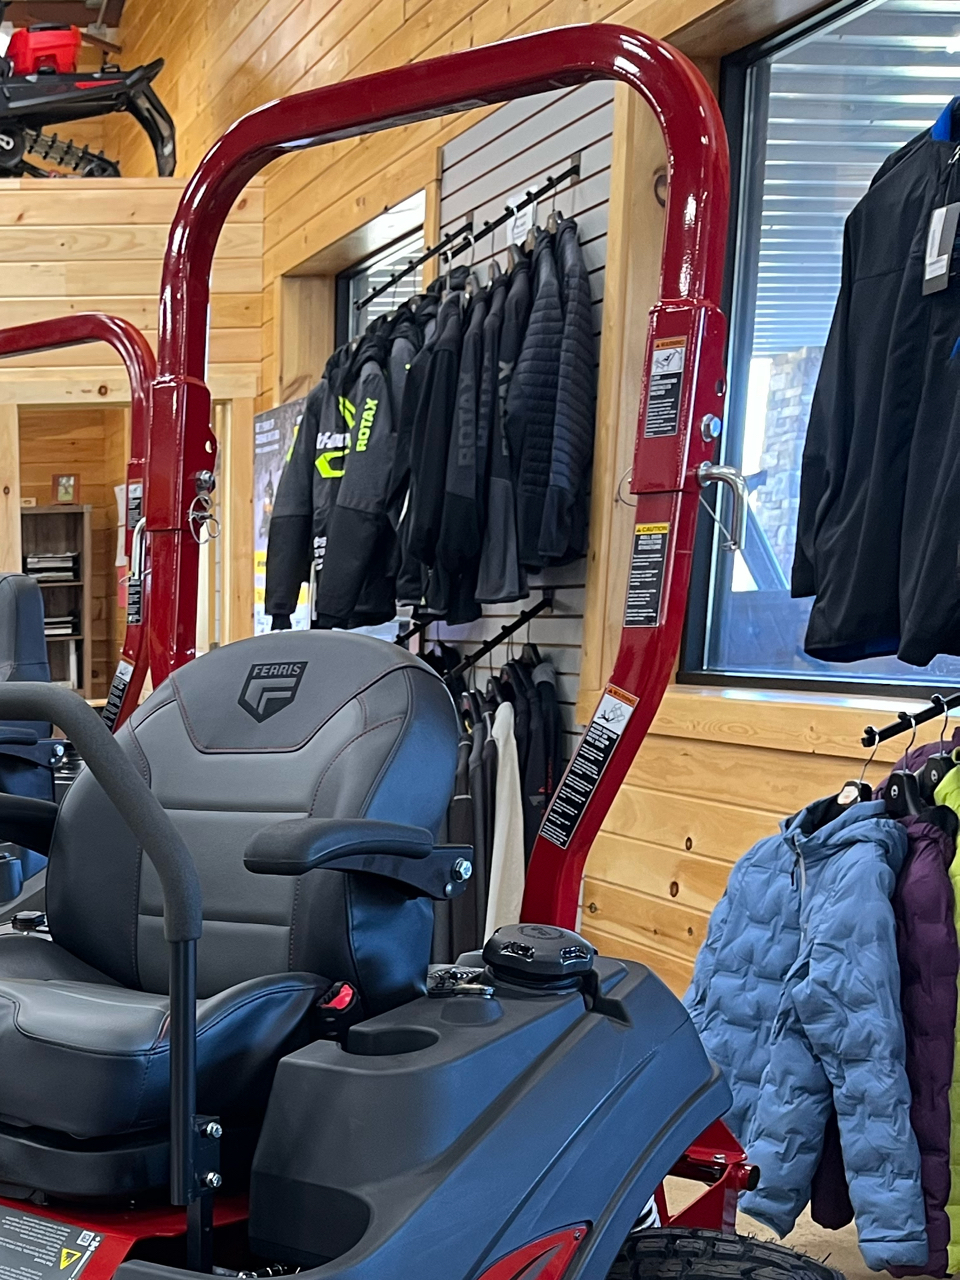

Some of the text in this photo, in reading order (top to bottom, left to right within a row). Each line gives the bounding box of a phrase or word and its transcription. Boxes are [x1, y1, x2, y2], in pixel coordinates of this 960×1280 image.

[356, 398, 378, 452] ROTAX
[641, 525, 668, 533] CAUTION
[252, 664, 302, 677] FERRIS
